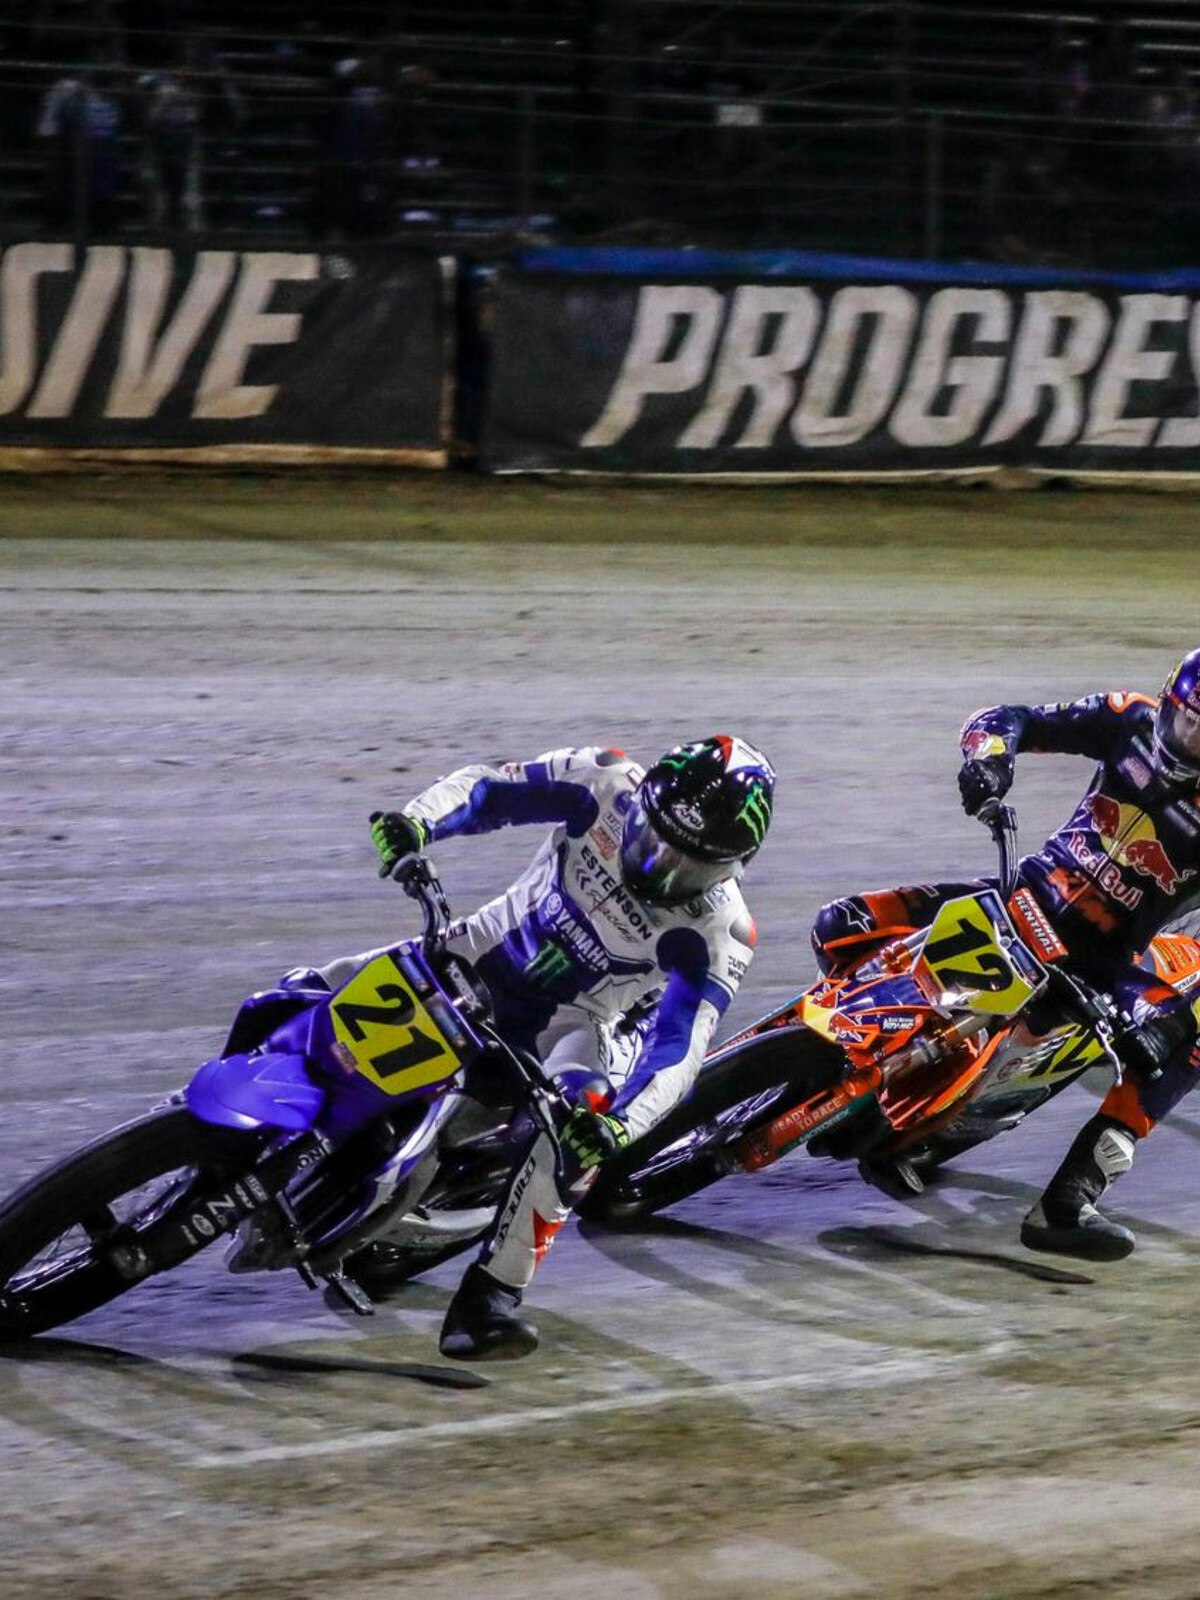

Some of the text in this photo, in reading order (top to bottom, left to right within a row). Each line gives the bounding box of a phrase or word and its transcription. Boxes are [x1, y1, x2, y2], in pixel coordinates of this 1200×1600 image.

[580, 845, 653, 941] ESTENSON
[1068, 831, 1145, 911] Red Bull
[555, 907, 610, 972] YAMAHA
[921, 917, 1015, 993] 12
[1014, 895, 1055, 955] RENTHAL
[333, 983, 447, 1079] 21
[811, 1094, 843, 1121] RACE
